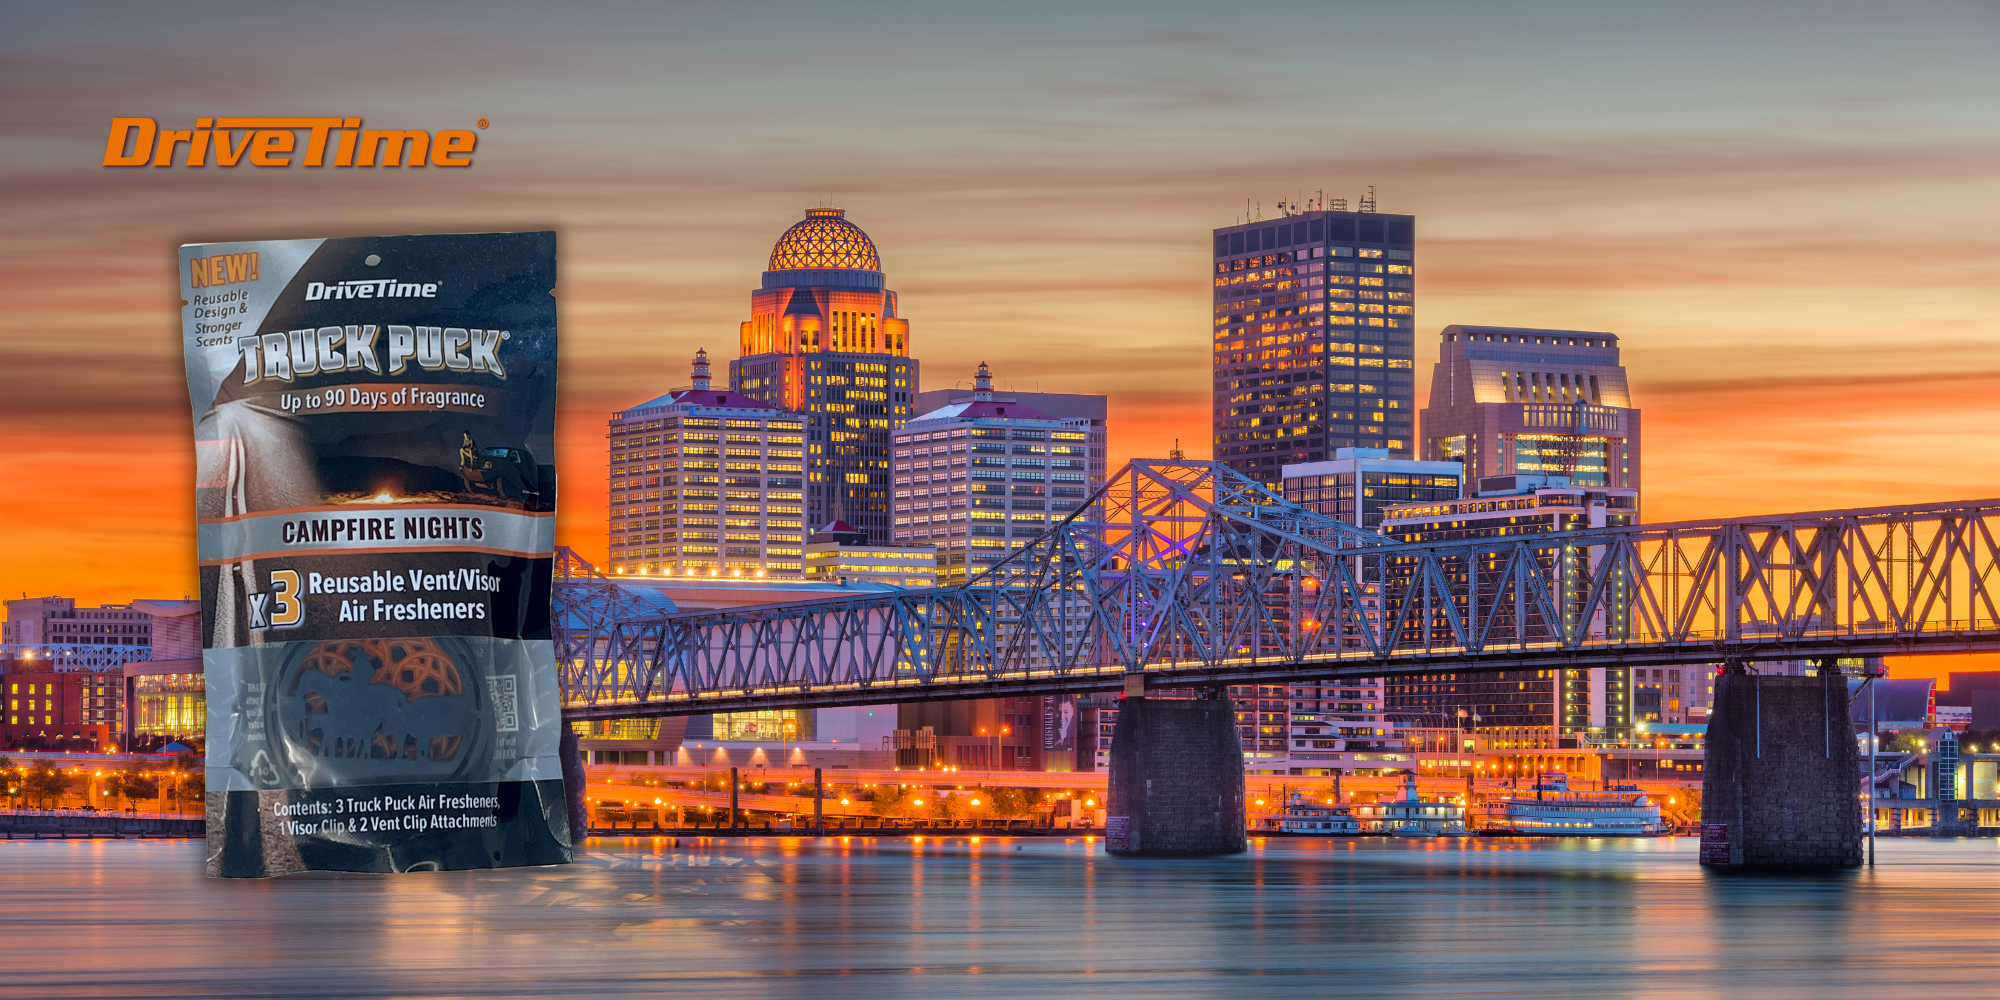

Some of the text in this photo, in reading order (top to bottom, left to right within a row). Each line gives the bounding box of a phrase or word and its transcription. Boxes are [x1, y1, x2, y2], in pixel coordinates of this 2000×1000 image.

[190, 252, 259, 289] NEW!
[194, 289, 248, 306] Reusable
[195, 302, 248, 319] Design &
[195, 321, 242, 334] Stronger
[196, 335, 233, 347] Scents
[237, 324, 382, 385] TRUCK
[281, 387, 485, 414] Up to 90 Days of Fragrance
[282, 517, 484, 543] CAMPFIRE NIGHTS
[309, 568, 501, 595] Reusable Vent/Visor
[338, 599, 485, 622] Air Fresheners
[1044, 695, 1054, 749] LOUISVILLE'S AL
[274, 794, 500, 817] Contents: 3 Truck Puck Air Fresheners,
[279, 813, 497, 835] 1 Visor Clip & 2 Vent Clip Attachments
